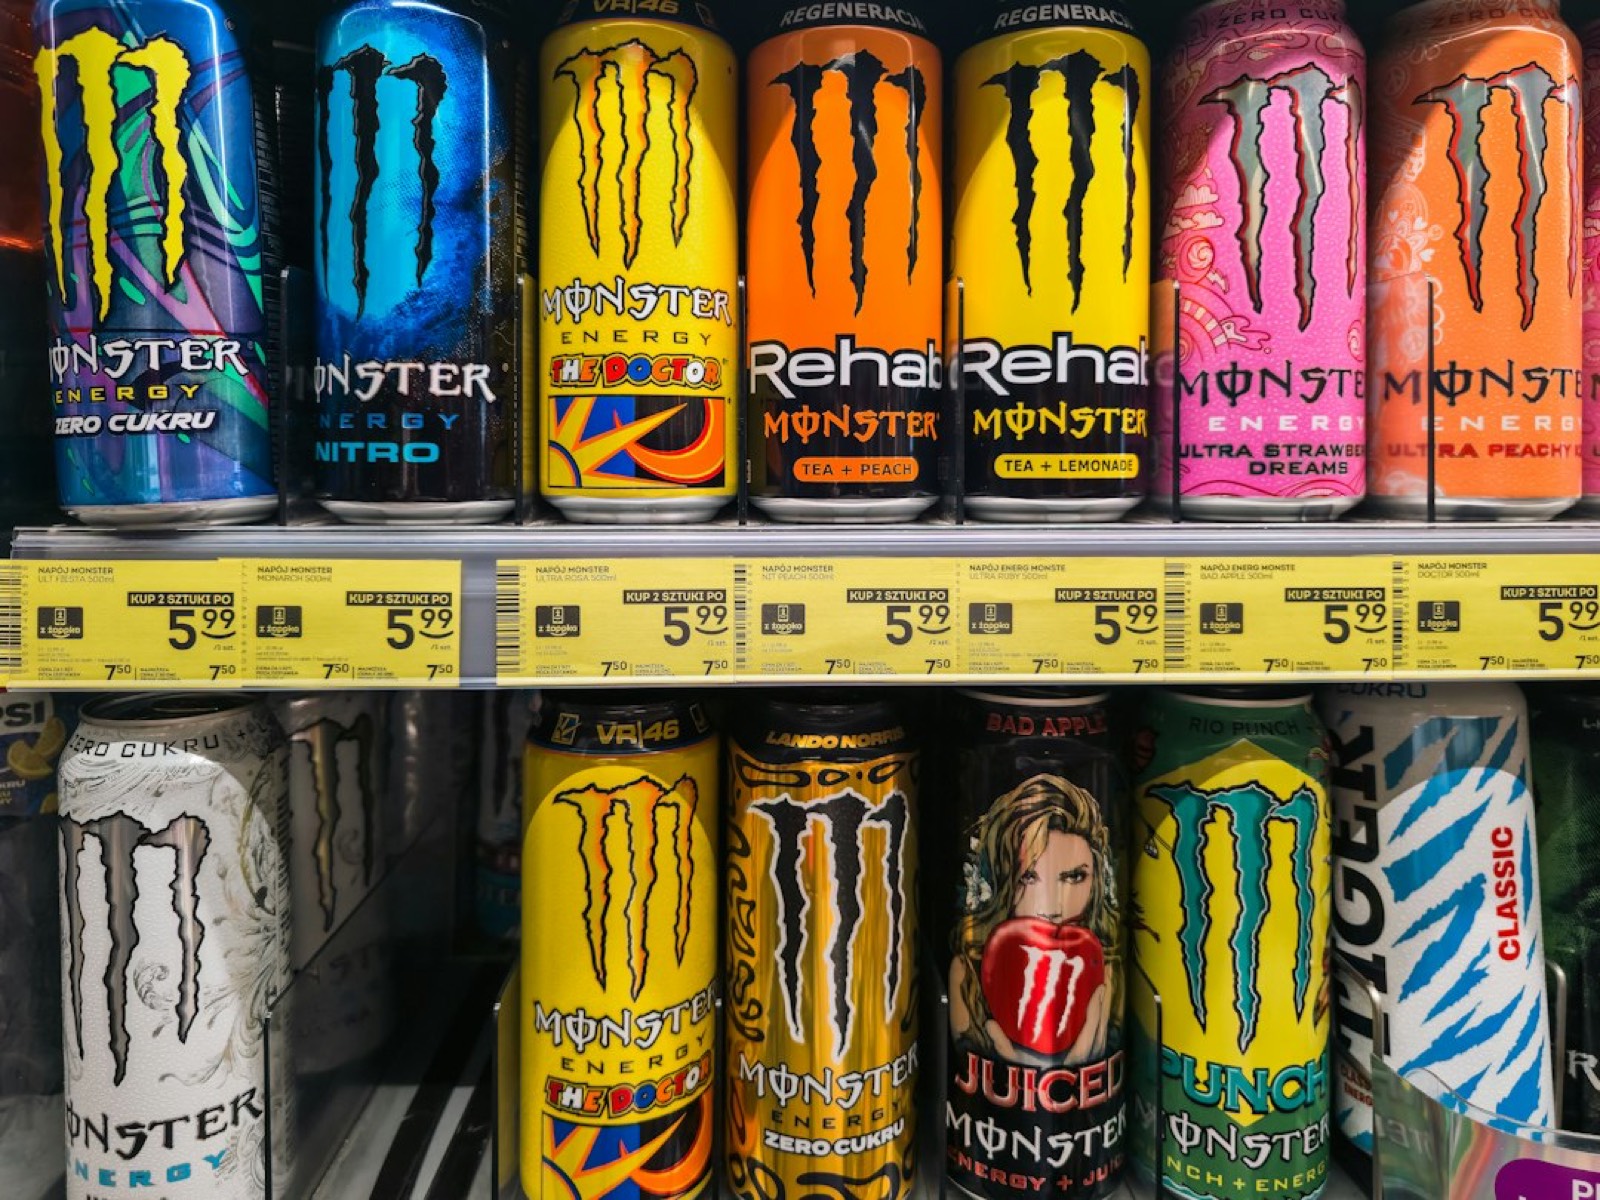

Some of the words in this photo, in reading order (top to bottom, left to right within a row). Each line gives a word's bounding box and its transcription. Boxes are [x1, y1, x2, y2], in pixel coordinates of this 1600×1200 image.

[1217, 8, 1286, 29] ZERO
[543, 275, 732, 327] MONSTER
[561, 329, 711, 346] ENERGY
[50, 334, 249, 384] ONSTER
[551, 353, 603, 388] THE
[603, 352, 722, 390] DOCTOR
[55, 384, 199, 404] ENERGY
[55, 416, 102, 435] ZERO
[108, 411, 216, 432] CUKRU
[764, 403, 938, 444] MONSTER
[973, 400, 1147, 441] MONSTER
[315, 441, 441, 463] NITRO
[802, 463, 834, 475] TEA
[860, 463, 912, 476] PEACH
[1004, 459, 1034, 472] TEA
[1059, 459, 1133, 472] LEMONADE
[1249, 461, 1348, 475] DREAMS
[131, 593, 155, 605] KUP
[158, 593, 165, 605] 2
[166, 593, 211, 605] SZTUKI
[213, 593, 232, 605] PO
[350, 593, 374, 605] KUP
[377, 593, 383, 605] 2
[386, 593, 429, 605] SZTUKI
[433, 593, 449, 605] PO
[626, 591, 650, 602] KUP
[653, 591, 659, 602] 2
[661, 591, 704, 602] SZTUKI
[707, 591, 724, 602] PO
[850, 591, 874, 602] KUP
[876, 591, 882, 602] 2
[885, 591, 926, 602] SZTUKI
[930, 591, 945, 602] PO
[1058, 590, 1081, 601] KUP
[1084, 590, 1090, 601] 2
[1093, 590, 1135, 601] SZTUKI
[1137, 590, 1154, 601] PO
[1287, 590, 1311, 600] KUP
[1314, 590, 1320, 600] 2
[1323, 590, 1364, 600] SZTUKI
[1366, 590, 1382, 600] PO
[1503, 588, 1526, 598] KUP
[1529, 588, 1535, 598] 2
[1538, 588, 1578, 598] SZTUKI
[1581, 588, 1596, 598] PO
[986, 712, 1036, 736] BAD
[1041, 710, 1108, 737] APPLE
[1189, 717, 1225, 734] RIO
[1232, 719, 1299, 736] PUNCH
[70, 734, 111, 757] ZERO
[120, 734, 220, 758] CUKRU
[765, 730, 839, 749] LANDO
[1491, 826, 1521, 961] CLASSIC
[561, 1029, 706, 1075] ENERGY
[546, 1075, 607, 1117] THE
[607, 1049, 712, 1118] DOCTOR
[739, 1040, 919, 1110] MONSTER
[954, 1049, 1126, 1114] JUICED
[66, 1086, 263, 1161] ONSTER
[771, 1100, 900, 1130] ENERGY
[764, 1129, 832, 1156] ZERO
[832, 1118, 905, 1156] CUKRU
[1162, 1110, 1330, 1169] ONSTER
[68, 1148, 228, 1189] NERGY
